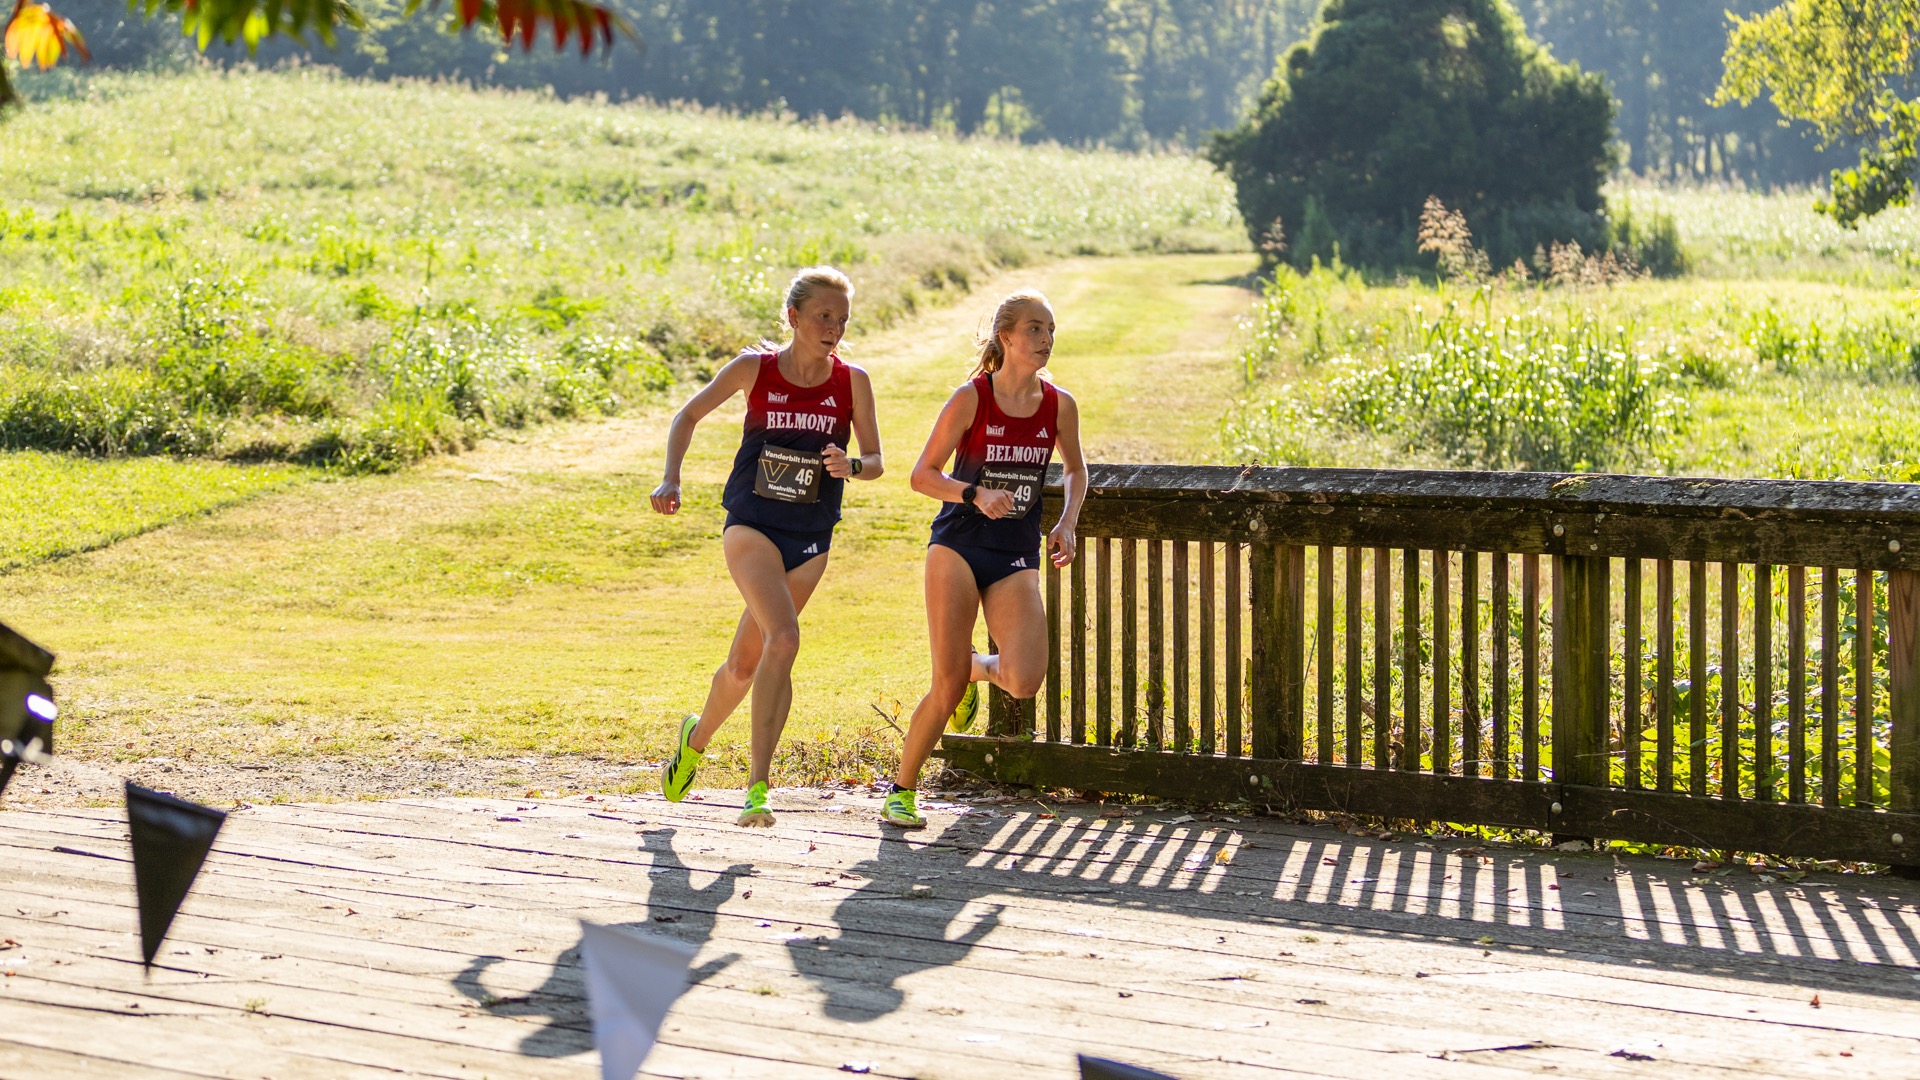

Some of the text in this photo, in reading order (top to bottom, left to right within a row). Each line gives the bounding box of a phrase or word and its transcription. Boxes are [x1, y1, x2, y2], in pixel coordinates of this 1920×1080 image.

[766, 411, 837, 435] BELMONT
[765, 450, 820, 465] Vanderbilt Invite
[985, 444, 1049, 466] BELMONT
[794, 468, 814, 486] 46
[985, 471, 1038, 482] Vanderbilt Invite
[768, 483, 797, 495] Nashville,
[1014, 485, 1031, 502] 49
